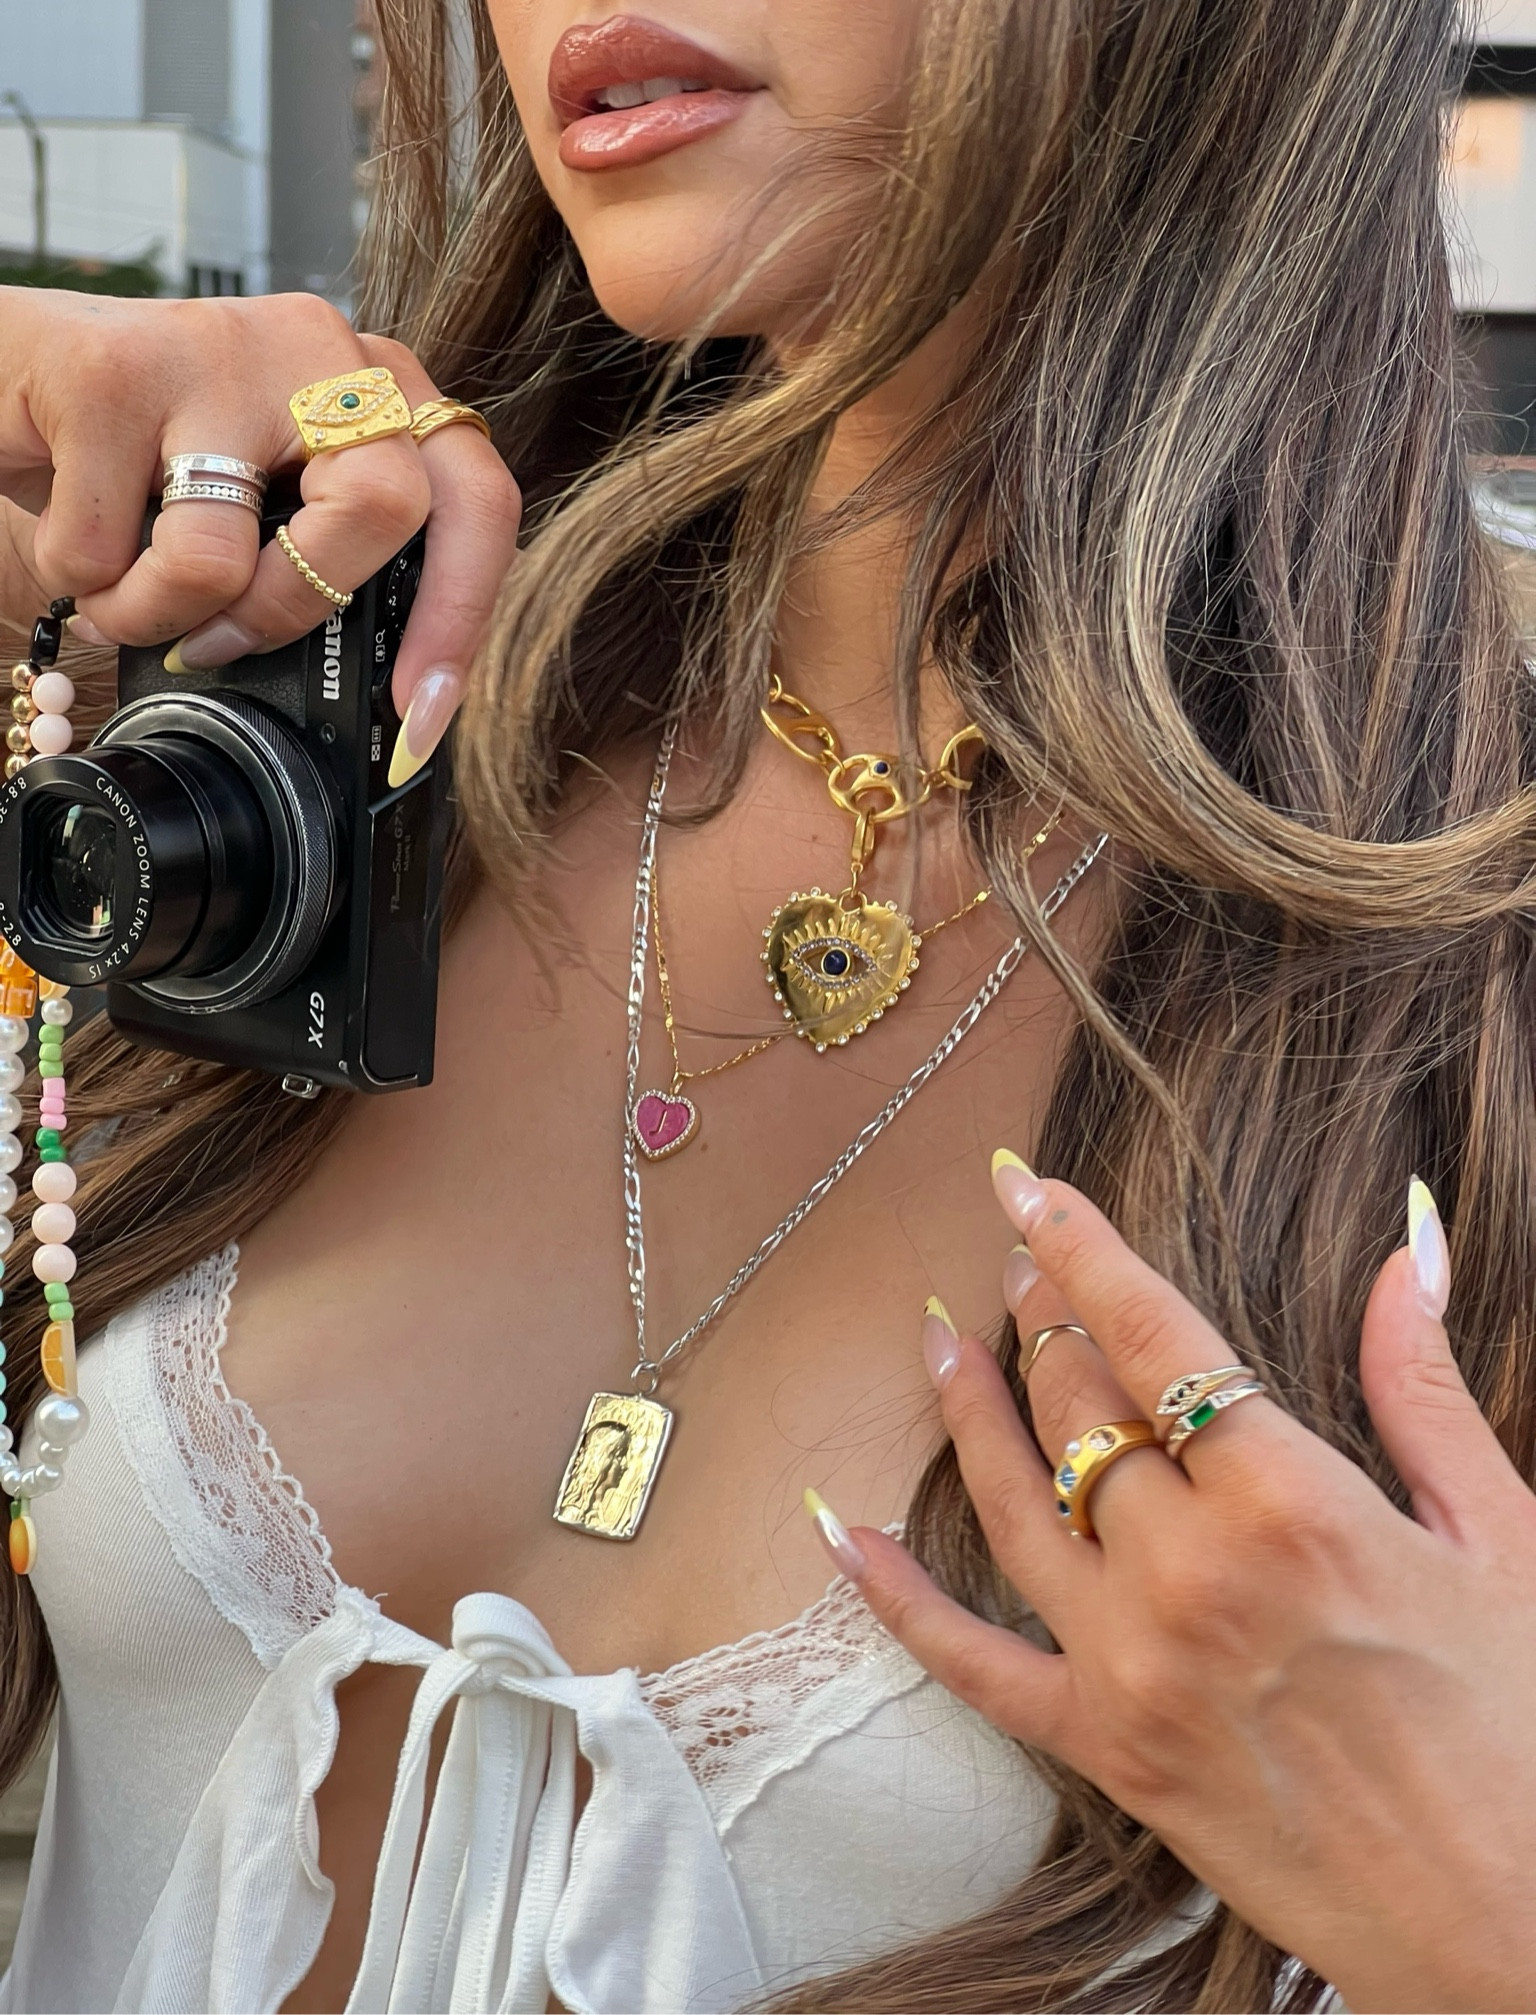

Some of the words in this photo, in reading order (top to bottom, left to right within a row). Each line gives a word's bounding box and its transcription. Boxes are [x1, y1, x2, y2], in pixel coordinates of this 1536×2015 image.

[322, 606, 346, 701] anon
[96, 776, 138, 829] CANON
[132, 833, 150, 889] ZOOM
[129, 896, 149, 941] LENS
[88, 963, 102, 979] IS
[104, 942, 130, 968] 4.2x
[308, 991, 325, 1049] G7X
